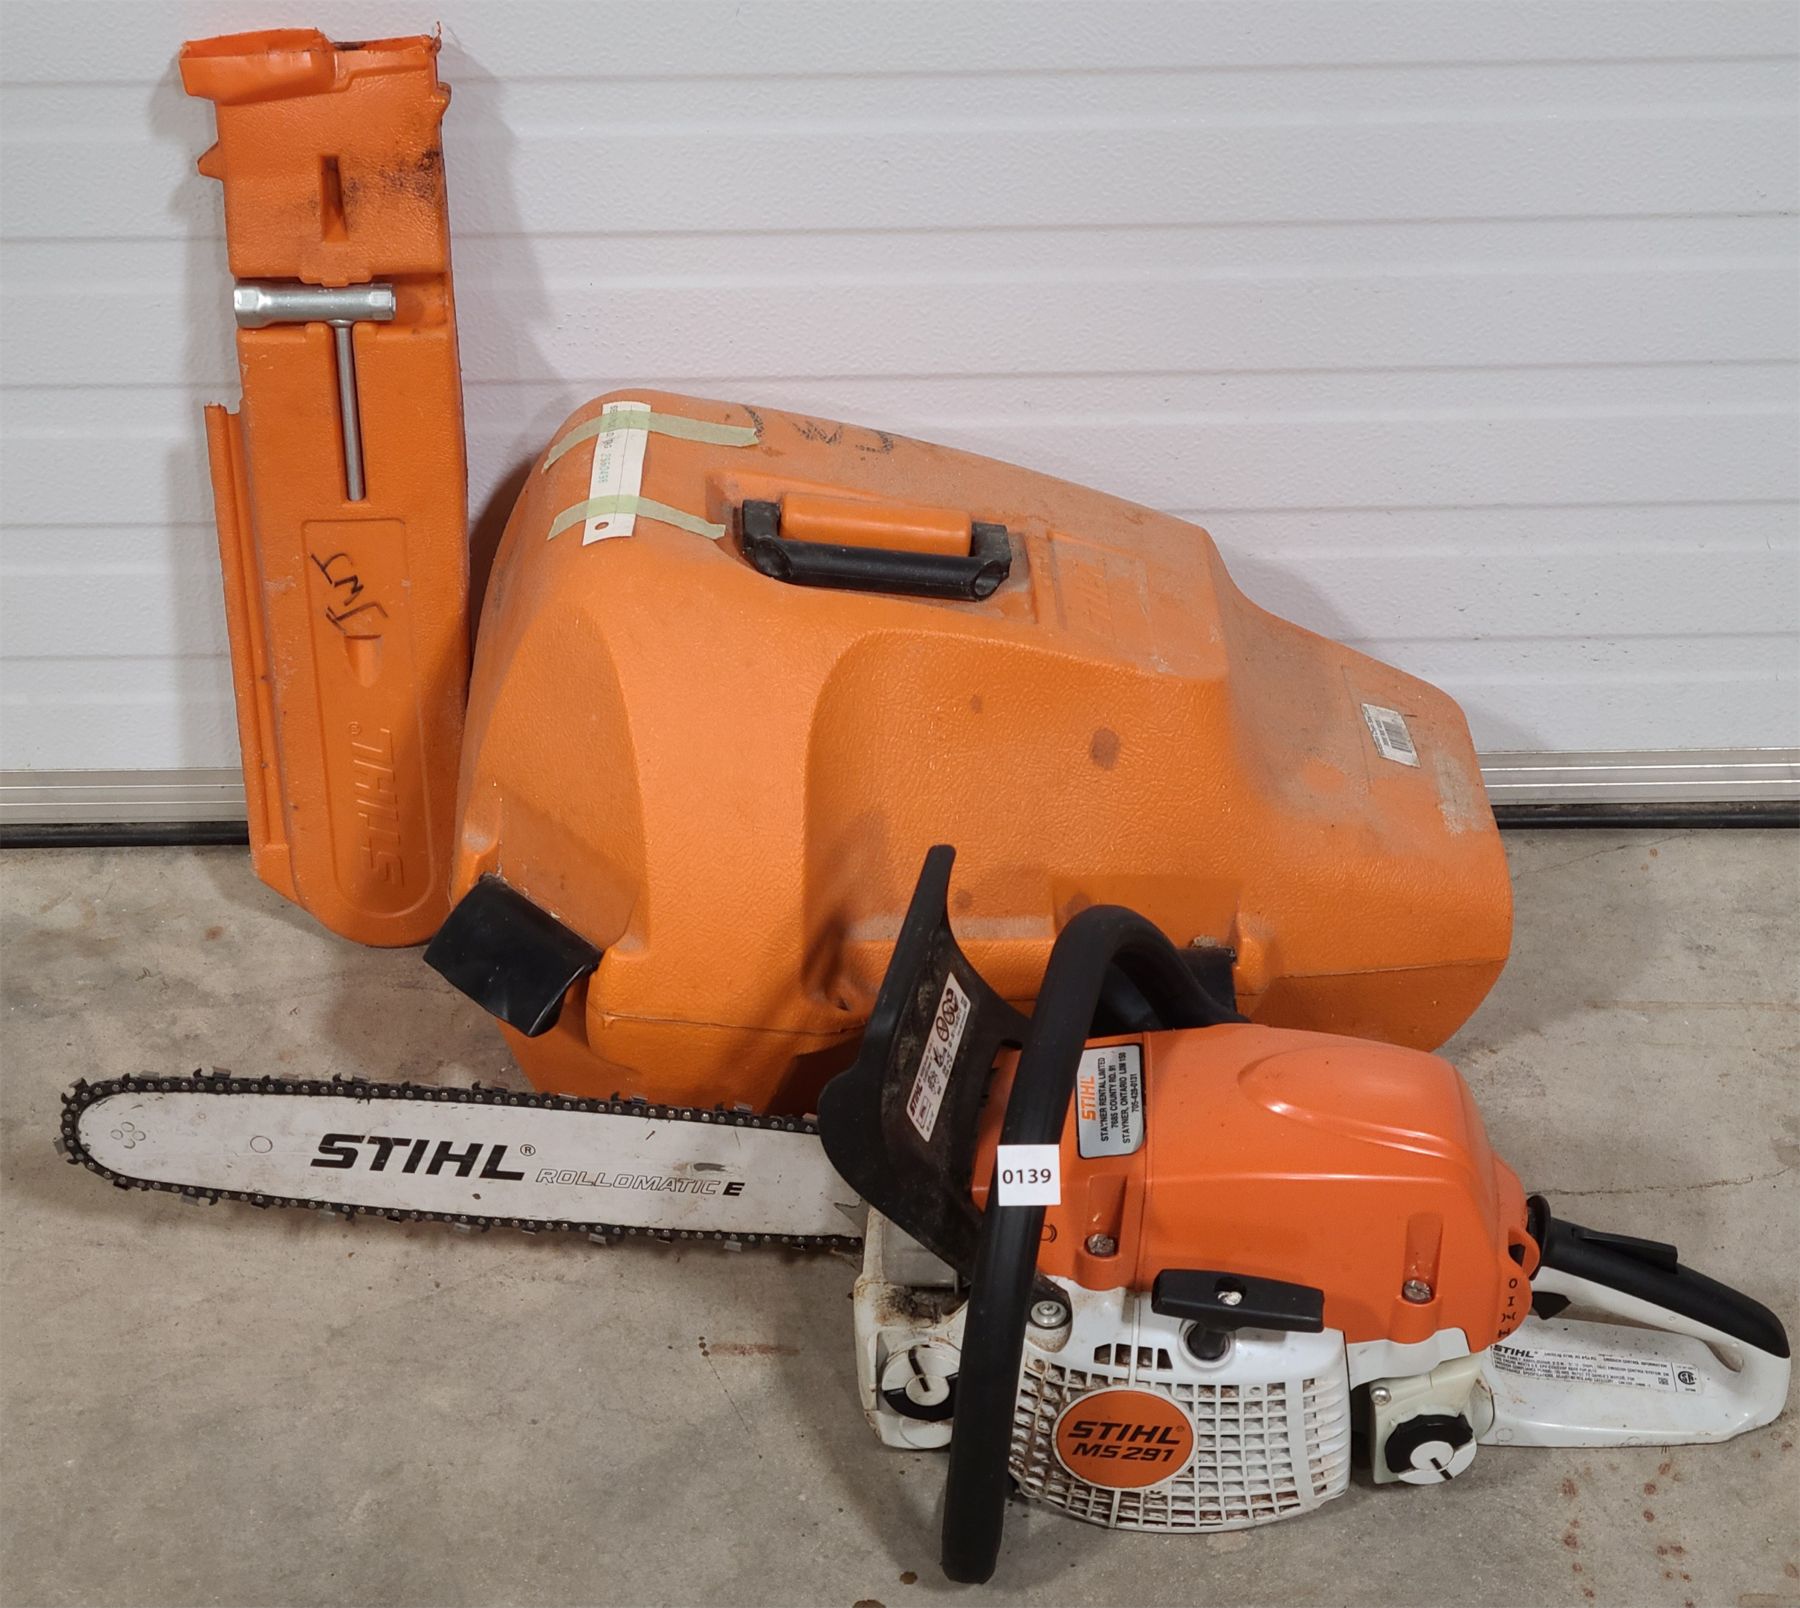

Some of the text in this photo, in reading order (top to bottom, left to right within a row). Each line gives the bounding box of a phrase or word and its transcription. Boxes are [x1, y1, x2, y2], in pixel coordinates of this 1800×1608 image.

[351, 727, 405, 888] STIHL
[1080, 1076, 1096, 1121] STIHL
[1099, 1080, 1107, 1107] RENTAL
[1109, 1084, 1118, 1111] COUNTY
[1120, 1076, 1129, 1106] ONTARIO
[310, 1133, 746, 1197] STIHL ROLLOMATIC E
[1002, 1168, 1052, 1184] 0139
[1493, 1344, 1535, 1358] STIHL
[1068, 1420, 1181, 1445] STIHL
[1072, 1443, 1175, 1462] MS 291
